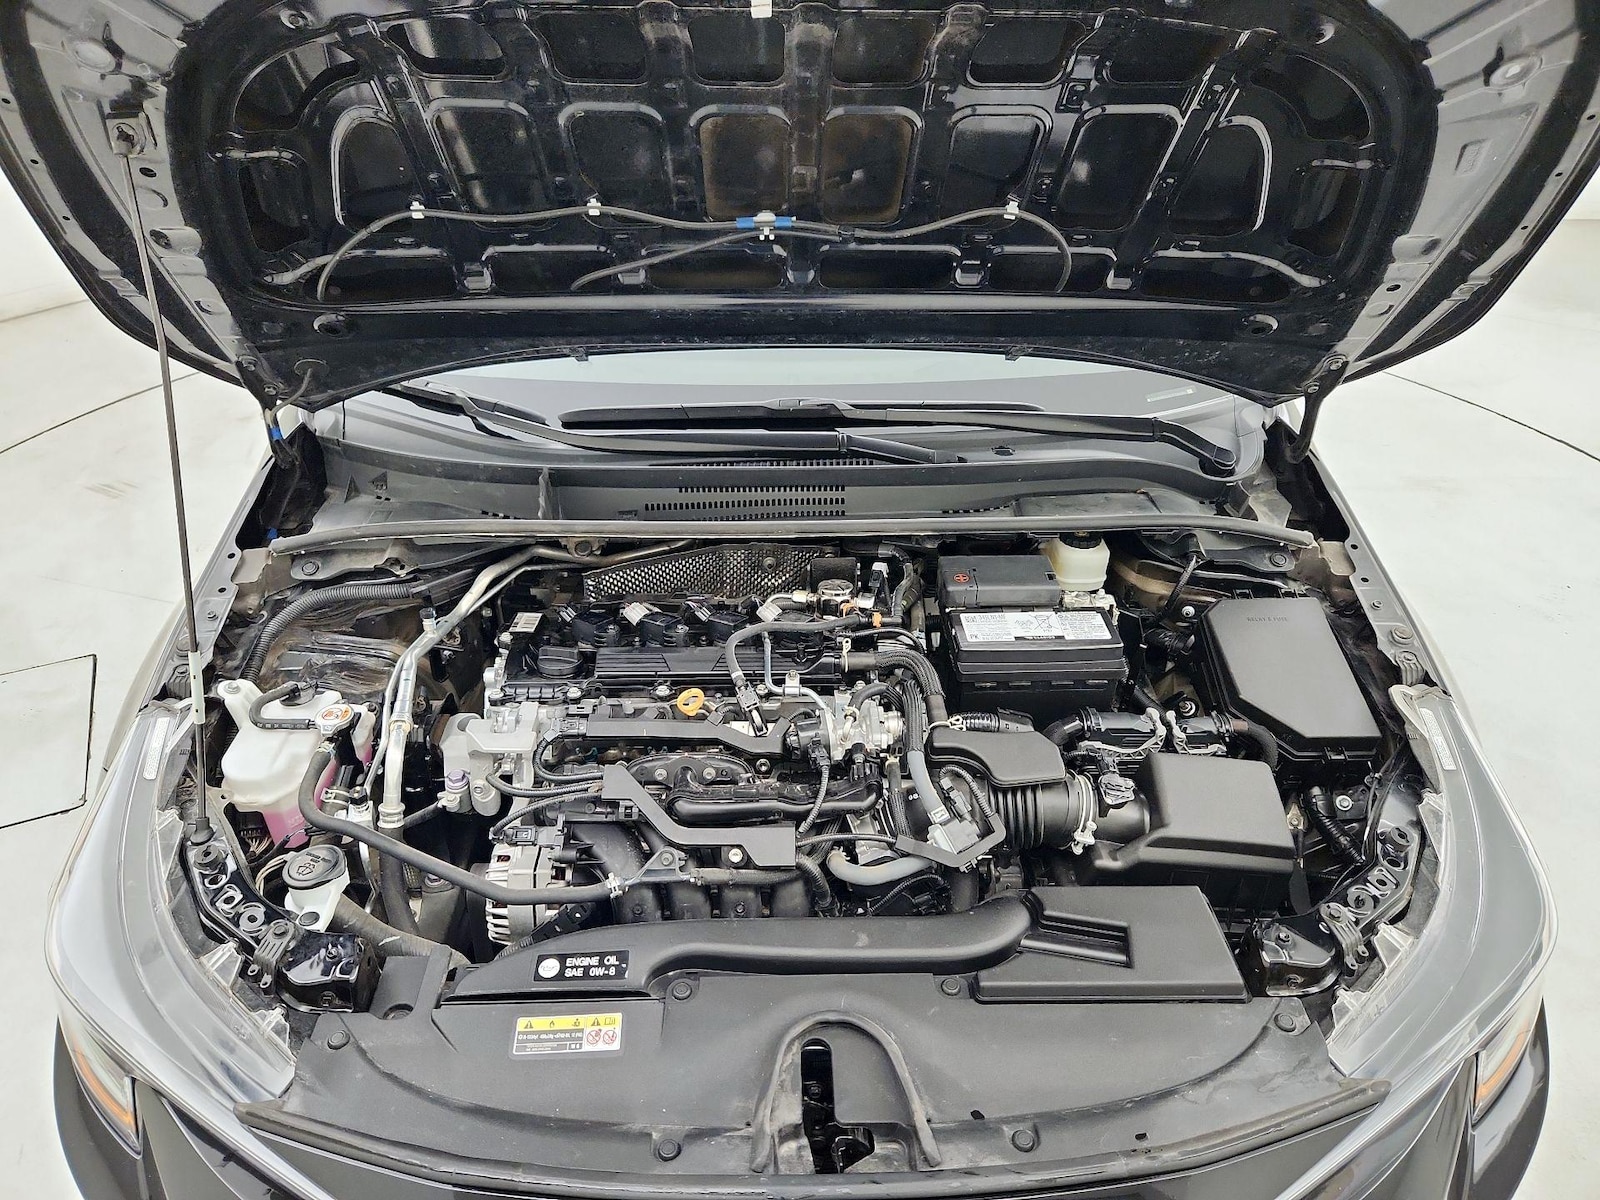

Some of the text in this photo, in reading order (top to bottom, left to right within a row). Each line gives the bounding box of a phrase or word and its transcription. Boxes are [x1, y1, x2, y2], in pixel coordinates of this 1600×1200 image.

[565, 955, 620, 967] ENGINE OIL
[564, 966, 616, 977] SAE 0W-8
